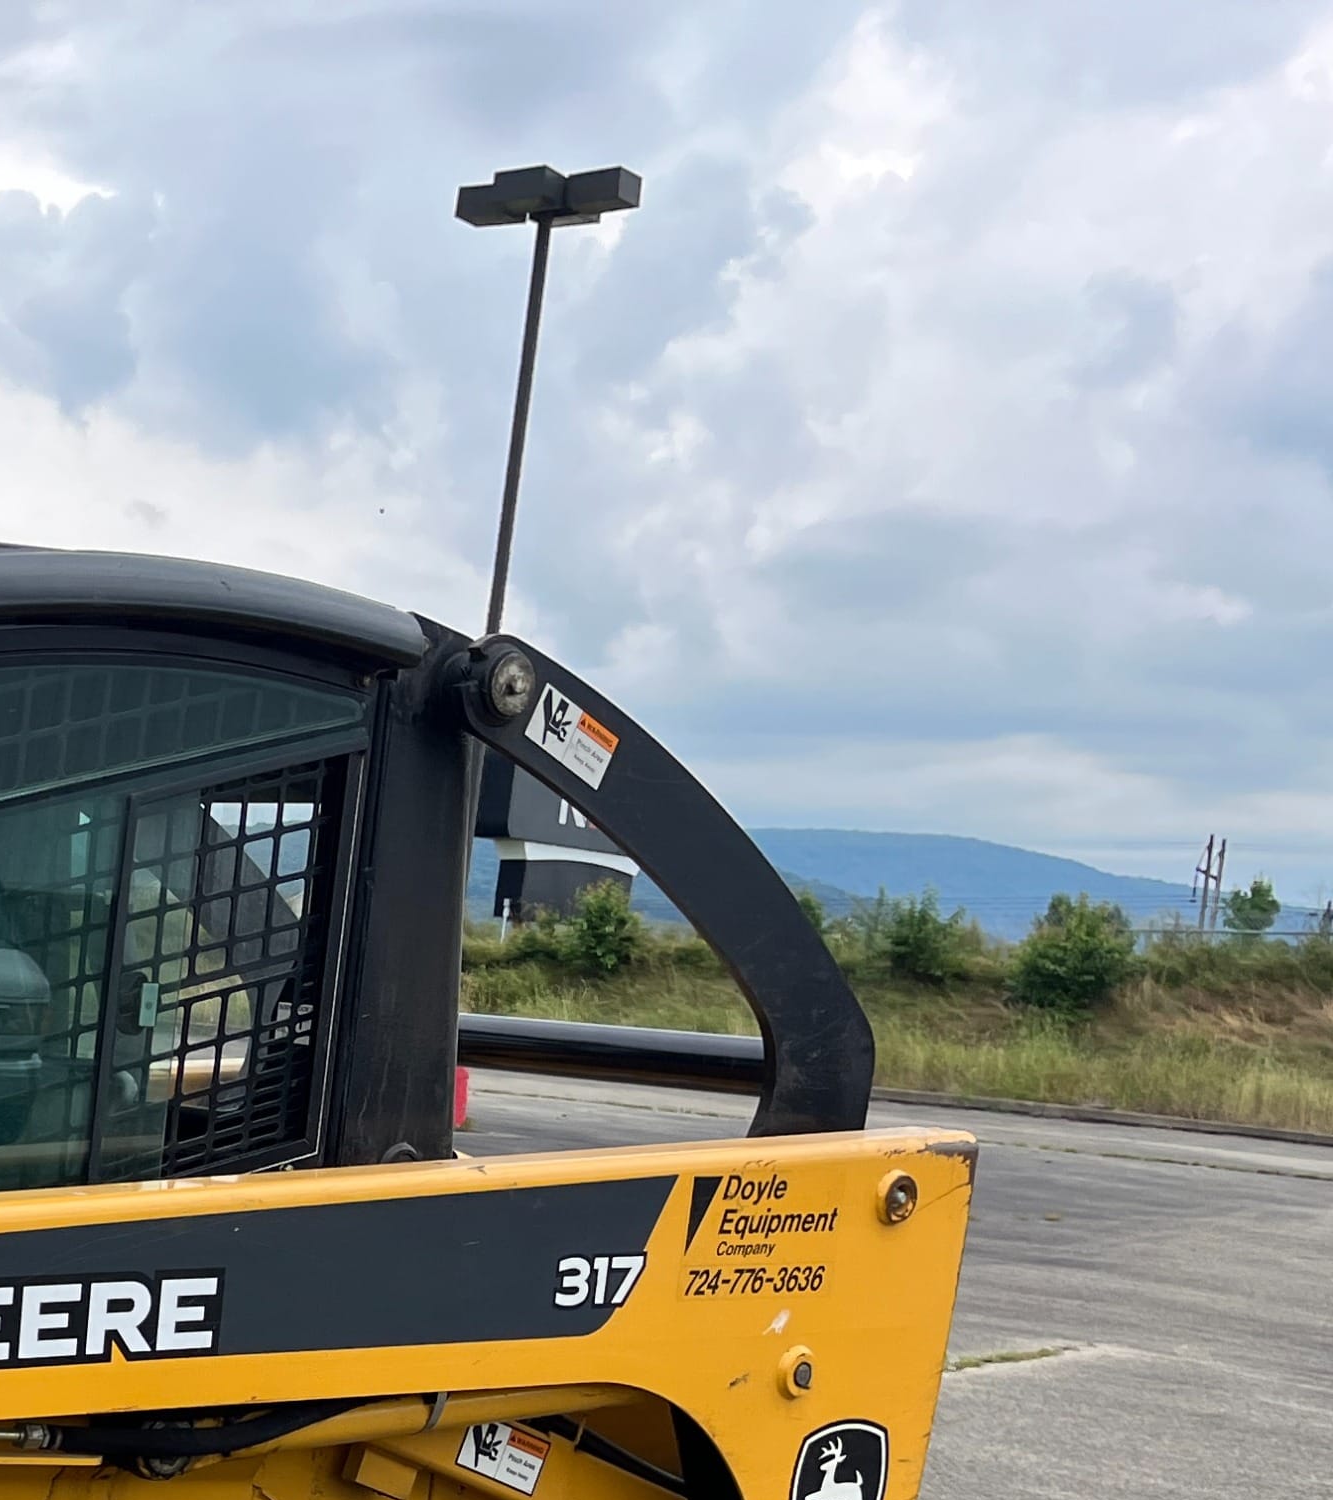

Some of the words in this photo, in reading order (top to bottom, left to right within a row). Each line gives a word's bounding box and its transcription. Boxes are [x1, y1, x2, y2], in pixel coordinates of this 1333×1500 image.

[723, 1174, 787, 1206] Doyle
[718, 1208, 838, 1240] Equipment
[717, 1241, 776, 1257] Company
[555, 1256, 644, 1306] 317
[684, 1265, 825, 1296] 724-776-3636
